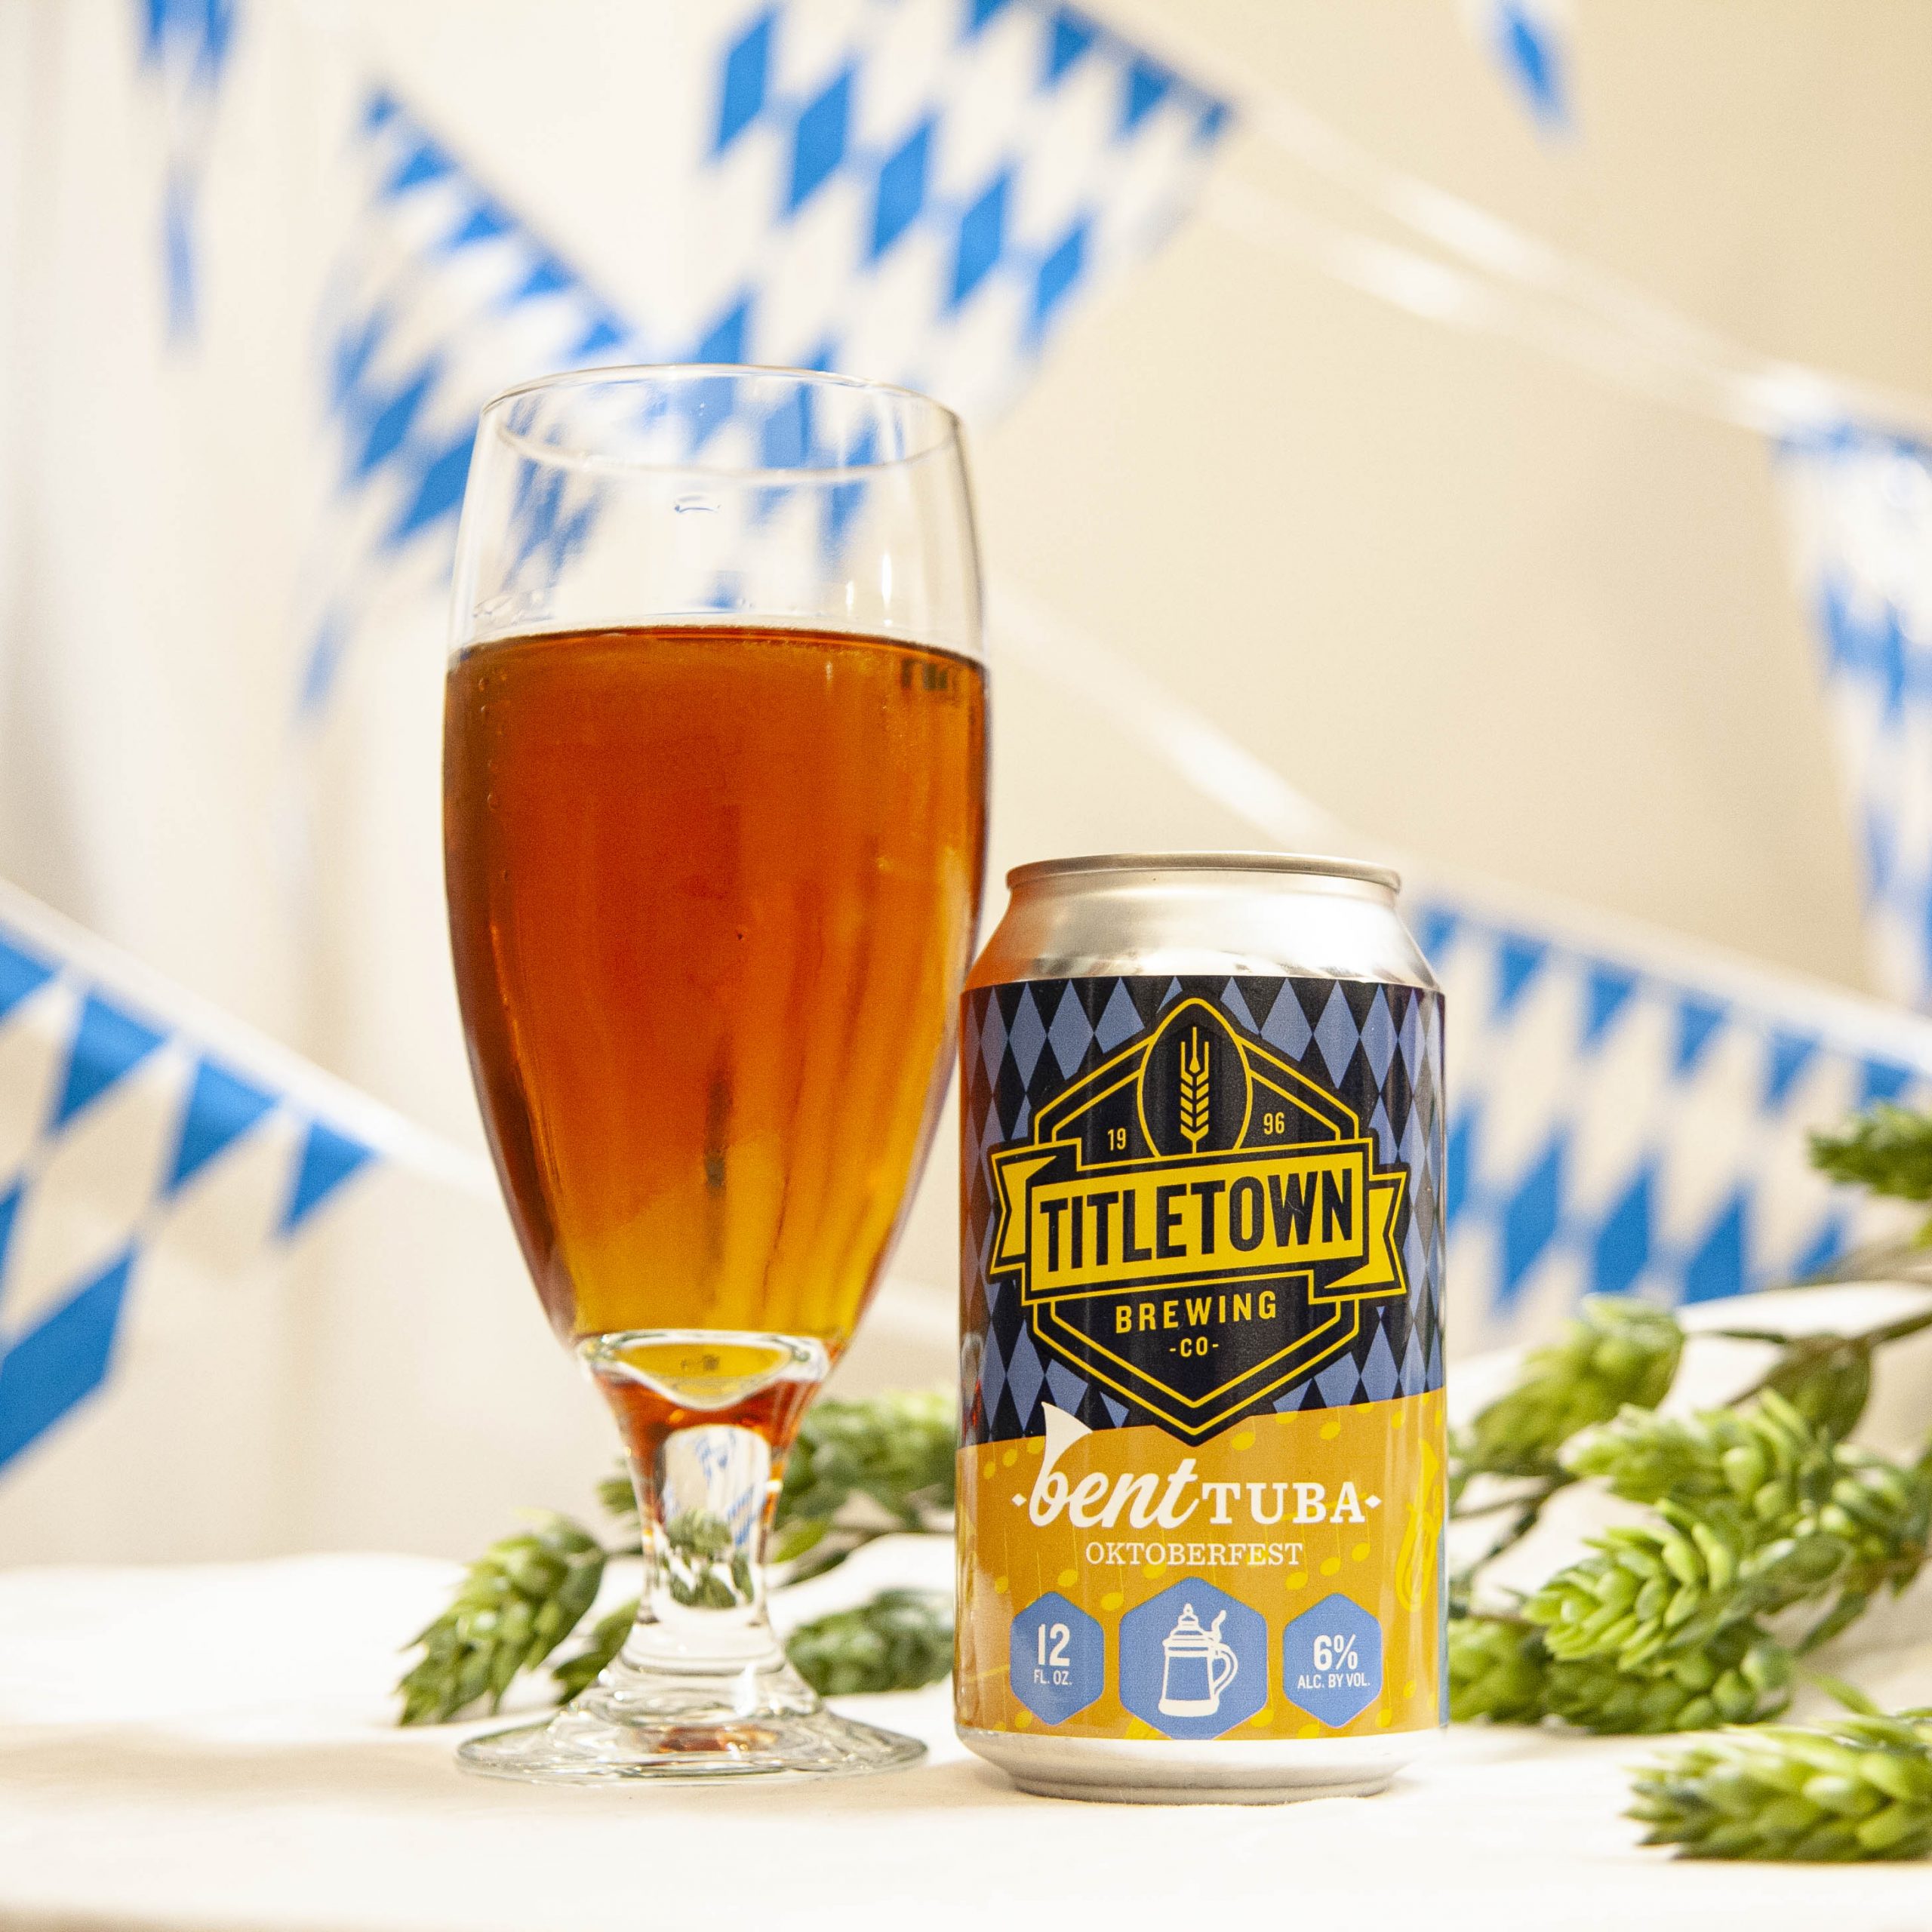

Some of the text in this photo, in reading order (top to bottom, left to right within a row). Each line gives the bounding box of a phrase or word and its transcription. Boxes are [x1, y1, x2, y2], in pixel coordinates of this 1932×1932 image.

[1106, 1112, 1286, 1151] 19 96
[1039, 1168, 1353, 1273] TITLETOWN
[1115, 1290, 1277, 1334] BREWING
[1029, 1401, 1365, 1530] bent TUBA
[1084, 1541, 1303, 1567] OKTOBERFEST
[1038, 1623, 1070, 1666] 12
[1314, 1634, 1358, 1671] 6%
[1033, 1669, 1072, 1686] FL. OZ.
[1297, 1672, 1371, 1690] ALC. BY VOL.
